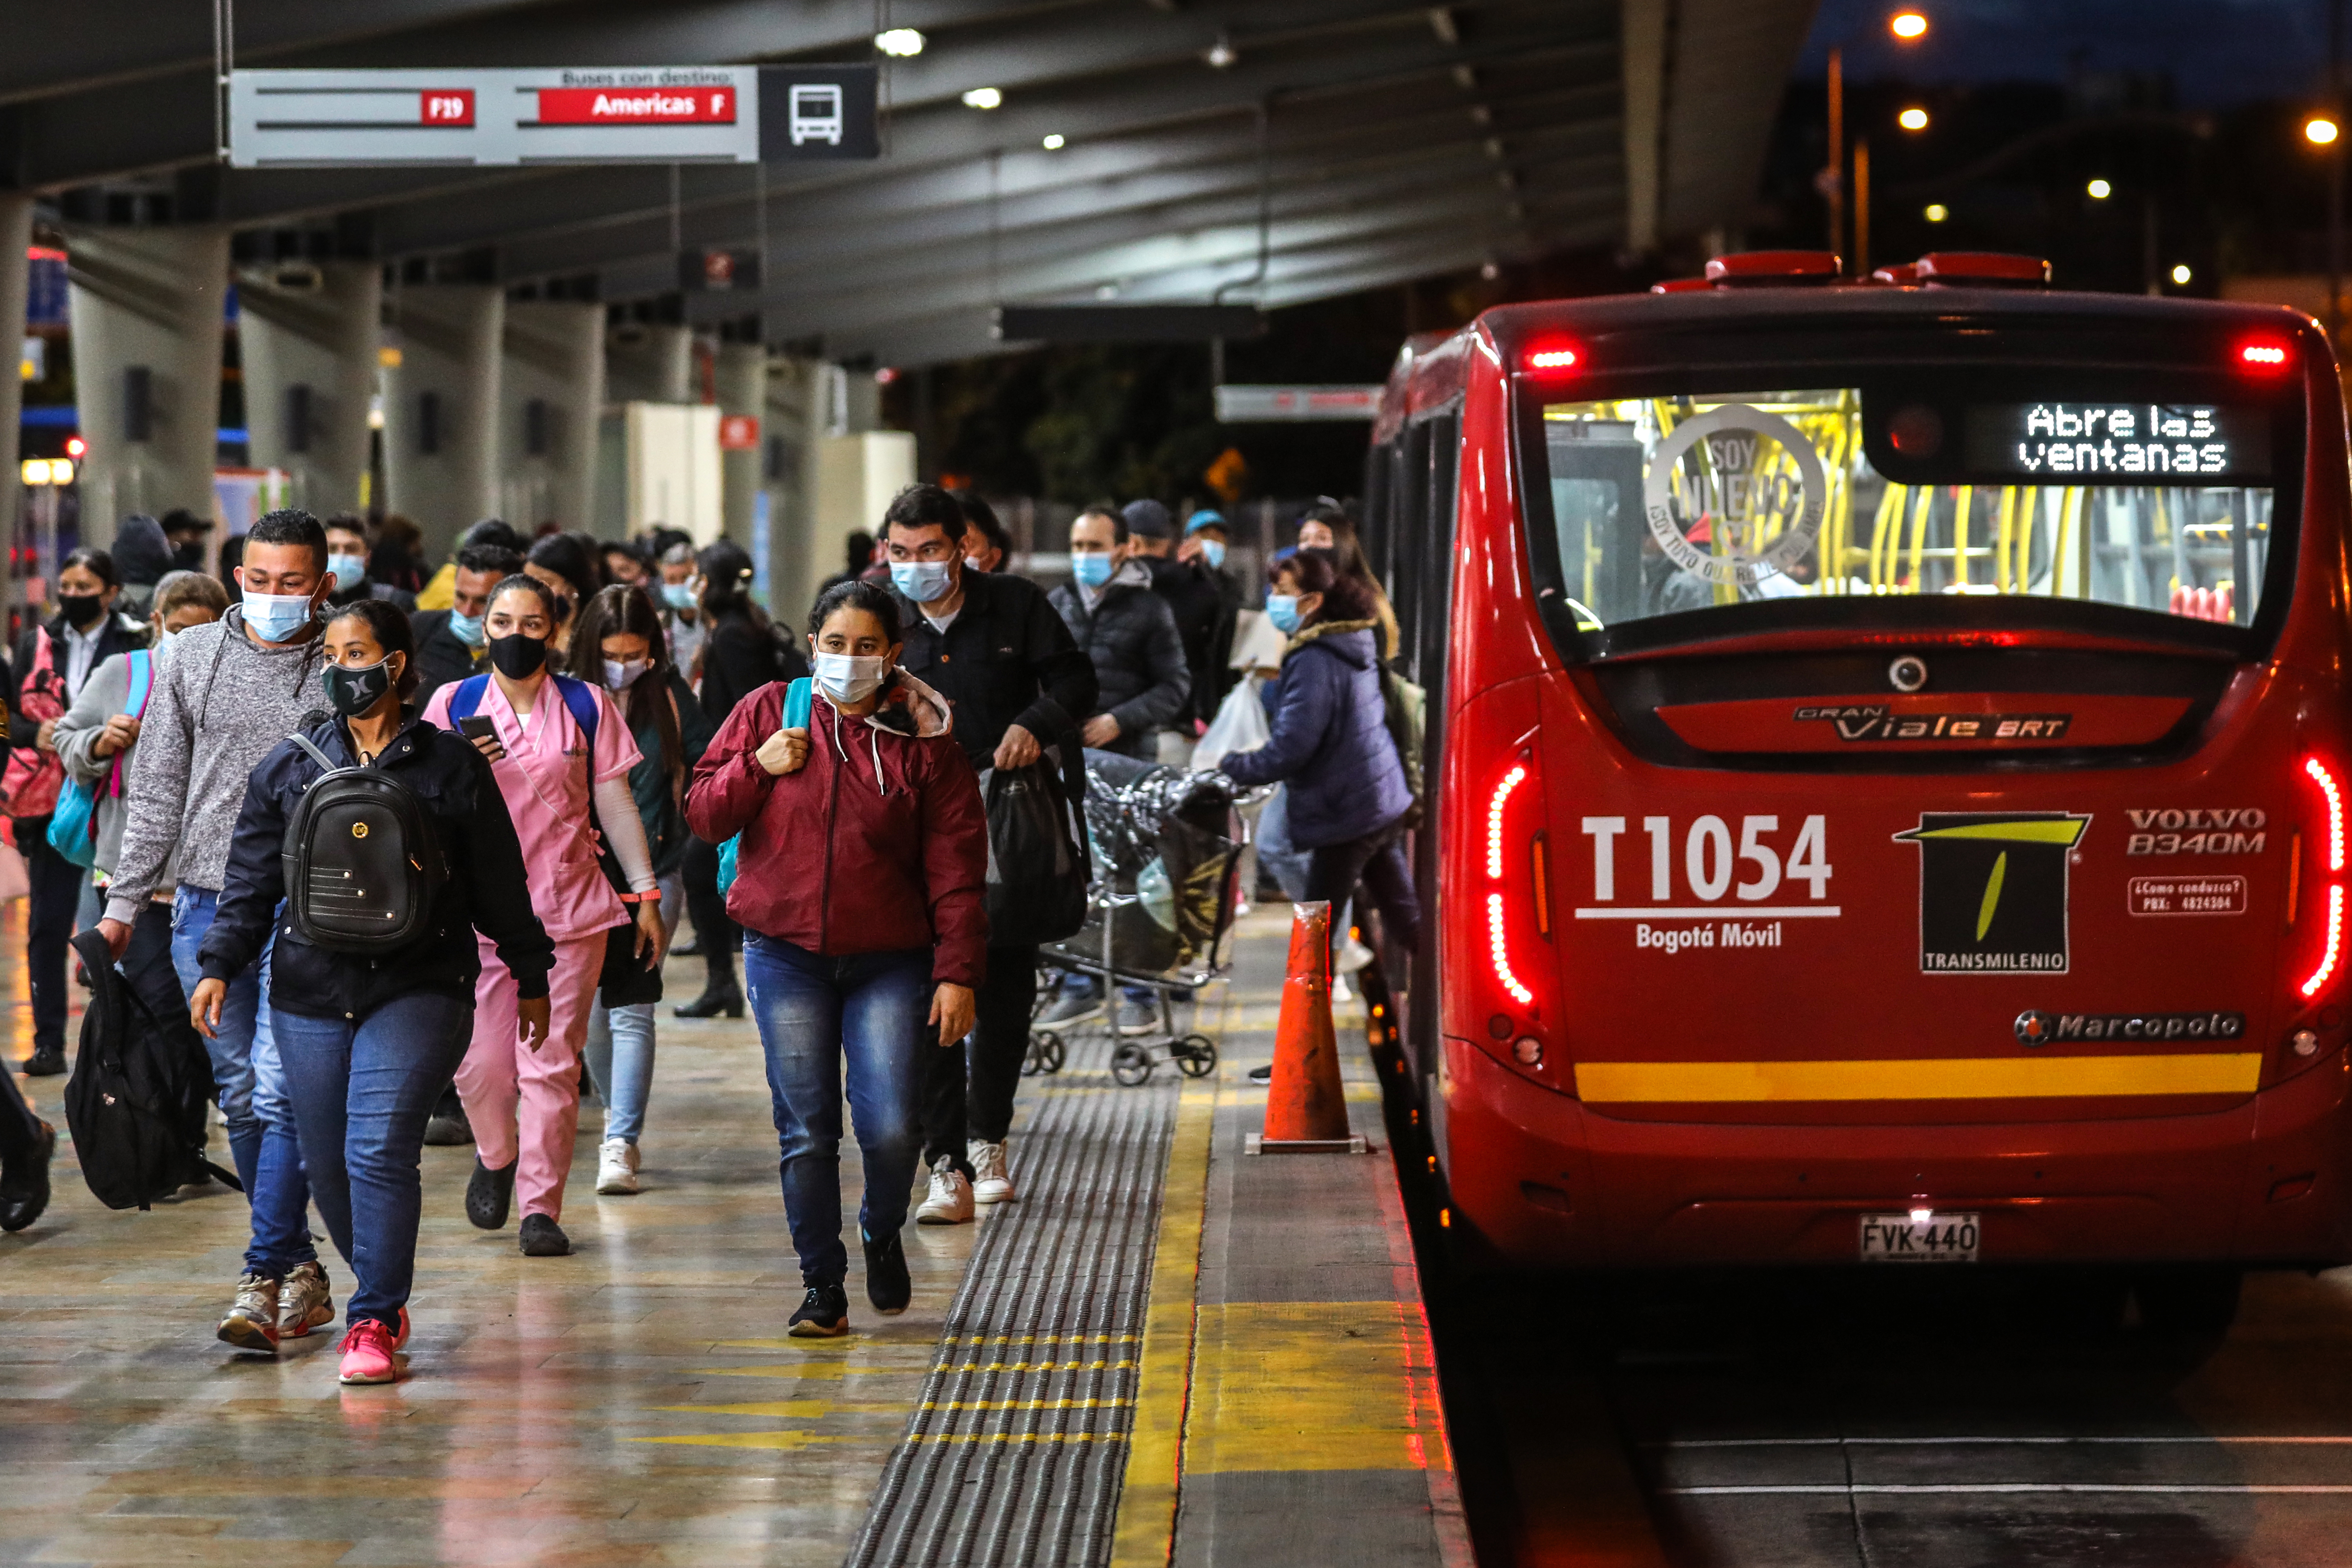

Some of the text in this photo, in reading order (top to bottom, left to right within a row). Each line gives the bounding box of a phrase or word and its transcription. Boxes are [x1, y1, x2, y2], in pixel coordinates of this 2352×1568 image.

[563, 70, 615, 85] Buses
[620, 72, 653, 85] con
[430, 97, 464, 118] F19
[592, 92, 726, 116] Americas F
[2028, 404, 2215, 437] Abre las
[1712, 439, 1757, 470] SOY
[2019, 439, 2226, 472] ventanas
[1678, 472, 1795, 519] NUEVO
[1797, 706, 1883, 719] GRAN
[1837, 716, 2064, 739] Viale BRT
[2124, 808, 2266, 829] VOLVO
[2126, 832, 2266, 855] B340M
[1582, 815, 1833, 901] T 1054
[1636, 921, 1782, 954] Bogotá Móvil
[1925, 953, 2064, 969] TRANSMILENIO
[2056, 1013, 2240, 1039] Marcopolo
[1864, 1224, 1976, 1250] FVK-440
